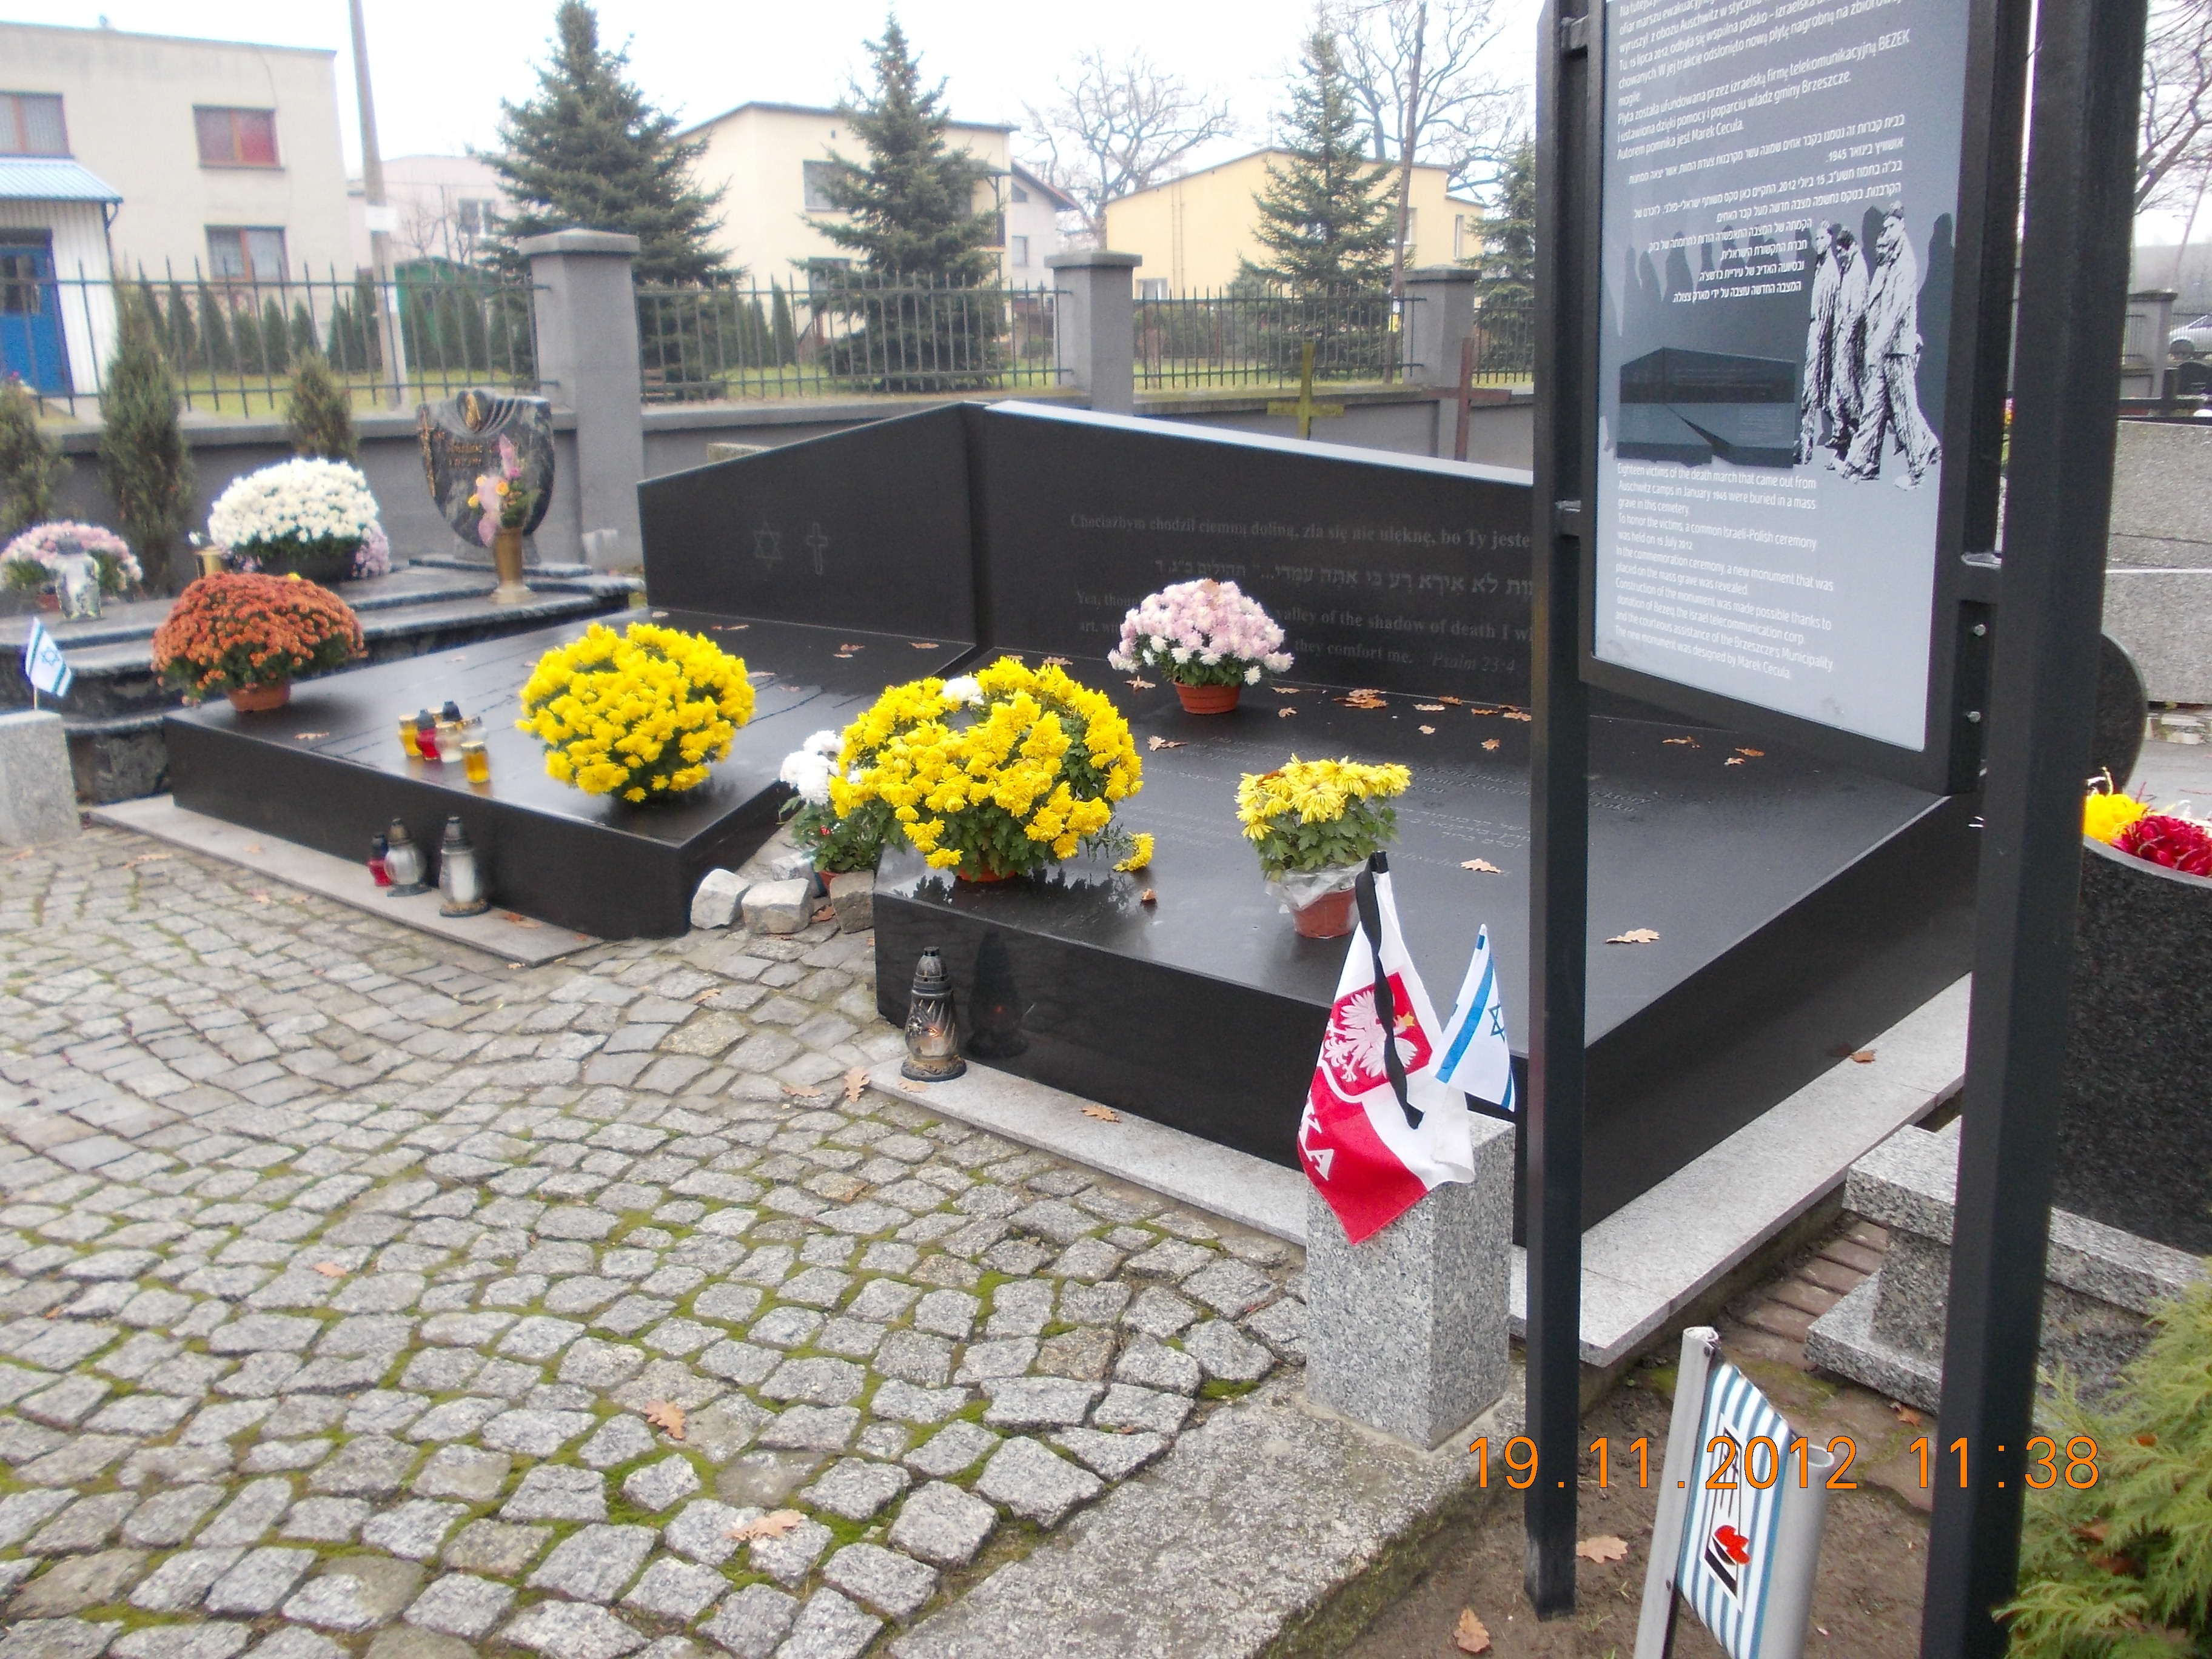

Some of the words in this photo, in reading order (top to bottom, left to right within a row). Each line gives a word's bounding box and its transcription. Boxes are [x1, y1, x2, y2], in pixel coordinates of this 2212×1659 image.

[1679, 9, 1718, 31] Auschwitz
[1739, 12, 1768, 32] polsko
[1835, 5, 1849, 19] na
[1660, 91, 1706, 112] ufundowana
[1706, 84, 1729, 101] przez
[1789, 43, 1877, 75] telekomunikacyjną
[1878, 28, 1909, 50] BEZEK
[1677, 111, 1706, 129] pomocy
[1710, 100, 1746, 119] poparciu
[1774, 85, 1800, 103] gminy
[1883, 114, 1905, 128] בבית
[1617, 146, 1646, 159] Autorem
[1676, 131, 1691, 148] jest
[1691, 125, 1715, 141] Marek
[1816, 174, 1825, 184] 15
[1646, 467, 1669, 477] victims
[1670, 467, 1677, 478] of
[1677, 469, 1689, 479] the
[1691, 469, 1711, 480] death
[1713, 472, 1737, 482] march
[1738, 472, 1754, 484] that
[1755, 475, 1777, 486] came
[1779, 477, 1794, 487] out
[1794, 475, 1817, 489] from
[1617, 498, 1636, 509] grave
[1644, 499, 1657, 511] this
[1618, 480, 1651, 492] Auschwitz
[1652, 485, 1674, 496] camps
[1675, 487, 1682, 495] in
[1683, 486, 1711, 501] January
[1728, 492, 1748, 502] were
[1749, 492, 1776, 504] buried
[1777, 497, 1786, 506] in
[1786, 497, 1792, 506] a
[1793, 498, 1816, 509] mass
[1441, 528, 1461, 545] bo
[1465, 529, 1486, 549] Ty
[1626, 514, 1646, 526] honor
[1647, 517, 1658, 528] the
[1684, 523, 1689, 532] a
[1691, 524, 1722, 535] common
[1723, 526, 1774, 542] Israeli-Polish
[1774, 535, 1817, 551] ceremony
[1631, 531, 1646, 542] held
[1646, 535, 1655, 544] on
[1664, 535, 1678, 549] July
[1615, 562, 1637, 574] placed
[1637, 567, 1646, 575] on
[1646, 567, 1658, 578] the
[1658, 571, 1677, 581] mass
[1677, 574, 1698, 586] grave
[1698, 578, 1714, 589] was
[1622, 546, 1633, 557] the
[1634, 551, 1688, 566] commemoration
[1726, 565, 1732, 574] a
[1732, 566, 1749, 577] new
[1751, 569, 1794, 584] monument
[1796, 574, 1813, 588] that
[1815, 580, 1833, 591] was
[1615, 577, 1656, 594] Construction
[1656, 586, 1664, 596] of
[1664, 587, 1677, 598] the
[1677, 592, 1715, 606] monument
[1716, 599, 1732, 610] was
[1732, 602, 1754, 615] made
[1755, 607, 1790, 622] possible
[1791, 612, 1820, 628] thanks
[1821, 617, 1832, 630] to
[1321, 610, 1335, 625] of
[1340, 611, 1362, 628] the
[1368, 613, 1425, 633] shadow
[1430, 618, 1446, 635] of
[1450, 619, 1495, 638] death
[1627, 612, 1638, 623] the
[1673, 625, 1710, 640] assistance
[1711, 632, 1720, 642] of
[1720, 634, 1732, 646] the
[1645, 600, 1653, 610] of
[1676, 606, 1688, 618] the
[1689, 609, 1709, 622] Israel
[1709, 614, 1782, 638] telecommunication
[1327, 642, 1382, 660] comfort
[1677, 643, 1692, 653] was
[1692, 645, 1726, 662] designed
[1727, 652, 1737, 667] by
[1737, 655, 1761, 670] Marek
